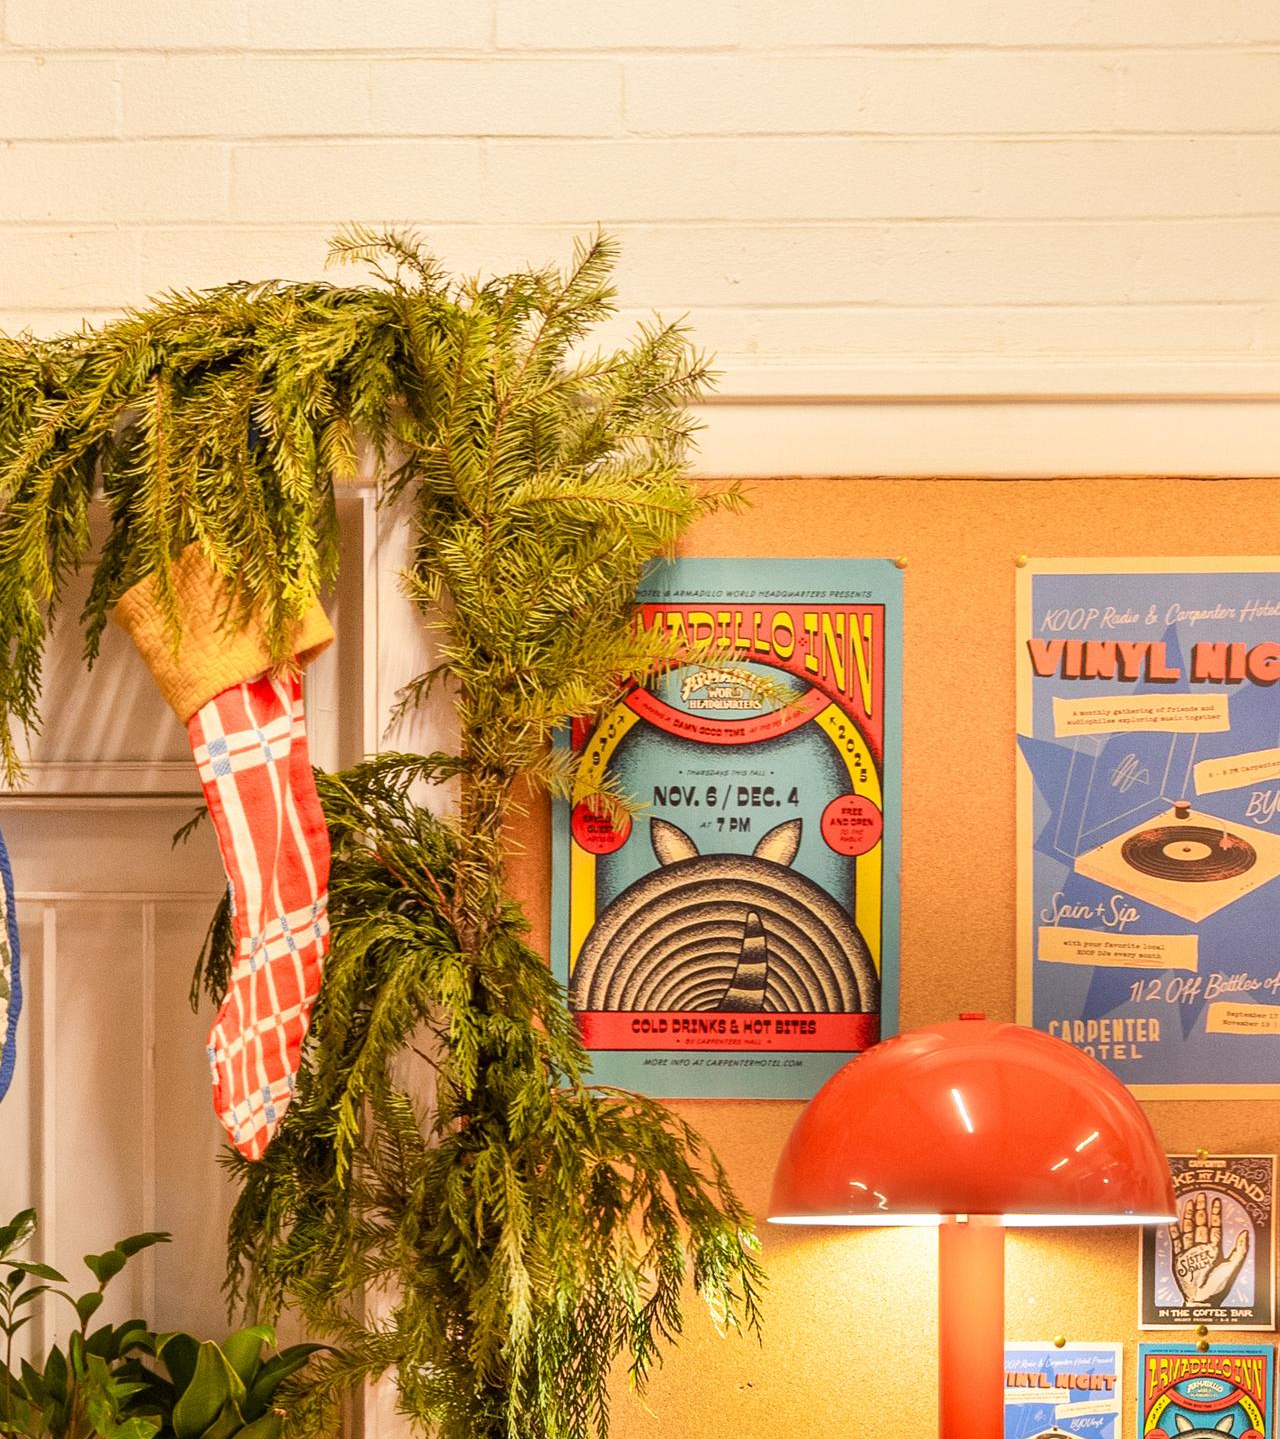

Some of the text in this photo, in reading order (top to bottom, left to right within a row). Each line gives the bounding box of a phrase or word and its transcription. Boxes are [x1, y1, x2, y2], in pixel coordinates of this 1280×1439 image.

[672, 590, 723, 598] ARMADILLO
[726, 590, 757, 598] WORLD
[759, 590, 827, 598] HEADQUARTERS
[829, 590, 873, 599] PRESENTS
[1041, 608, 1100, 632] KOOP
[1100, 606, 1140, 630] Radio
[1144, 604, 1159, 626] &
[1165, 602, 1236, 627] Carpenter
[636, 611, 873, 721] MADILLO INN
[1027, 638, 1280, 688] VINYL NIG
[688, 698, 762, 710] HEADQUARTERS
[1080, 709, 1111, 717] monthly
[1113, 707, 1153, 716] gathering
[672, 718, 698, 734] DAMN
[699, 727, 723, 737] GOOD
[723, 727, 746, 737] TIME
[1066, 713, 1221, 726] audiophiles exploring music together
[838, 725, 868, 783] 2025
[686, 769, 766, 778] THURSDAYS THIS FALL
[653, 784, 800, 811] NOV. 6 / DEC. 4
[841, 808, 863, 816] FREE
[716, 817, 725, 833] 7
[729, 817, 751, 833] PM
[830, 817, 874, 827] AND OPEN
[1104, 941, 1140, 949] favorite
[1143, 943, 1165, 951] local
[1113, 951, 1137, 959] every
[1164, 976, 1203, 1005] Off
[1204, 973, 1263, 1000] Bottles
[631, 1018, 817, 1036] COLD DRINKS & HOT BITES
[1048, 1017, 1161, 1043] CARPENTER
[697, 1038, 742, 1046] CARPENTERS
[744, 1038, 762, 1046] HALL
[1083, 1043, 1144, 1060] OTEL
[642, 1059, 803, 1068] MORE INFO AT CARPENTERHOTEL.COM
[1173, 1171, 1196, 1188] KE
[1214, 1170, 1265, 1203] HAND
[1177, 1249, 1214, 1278] SISTER
[1158, 1308, 1254, 1318] IN THE COFFEE BAR
[1055, 1373, 1118, 1391] NIGHT
[1148, 1357, 1263, 1401] ARMADILLO INN
